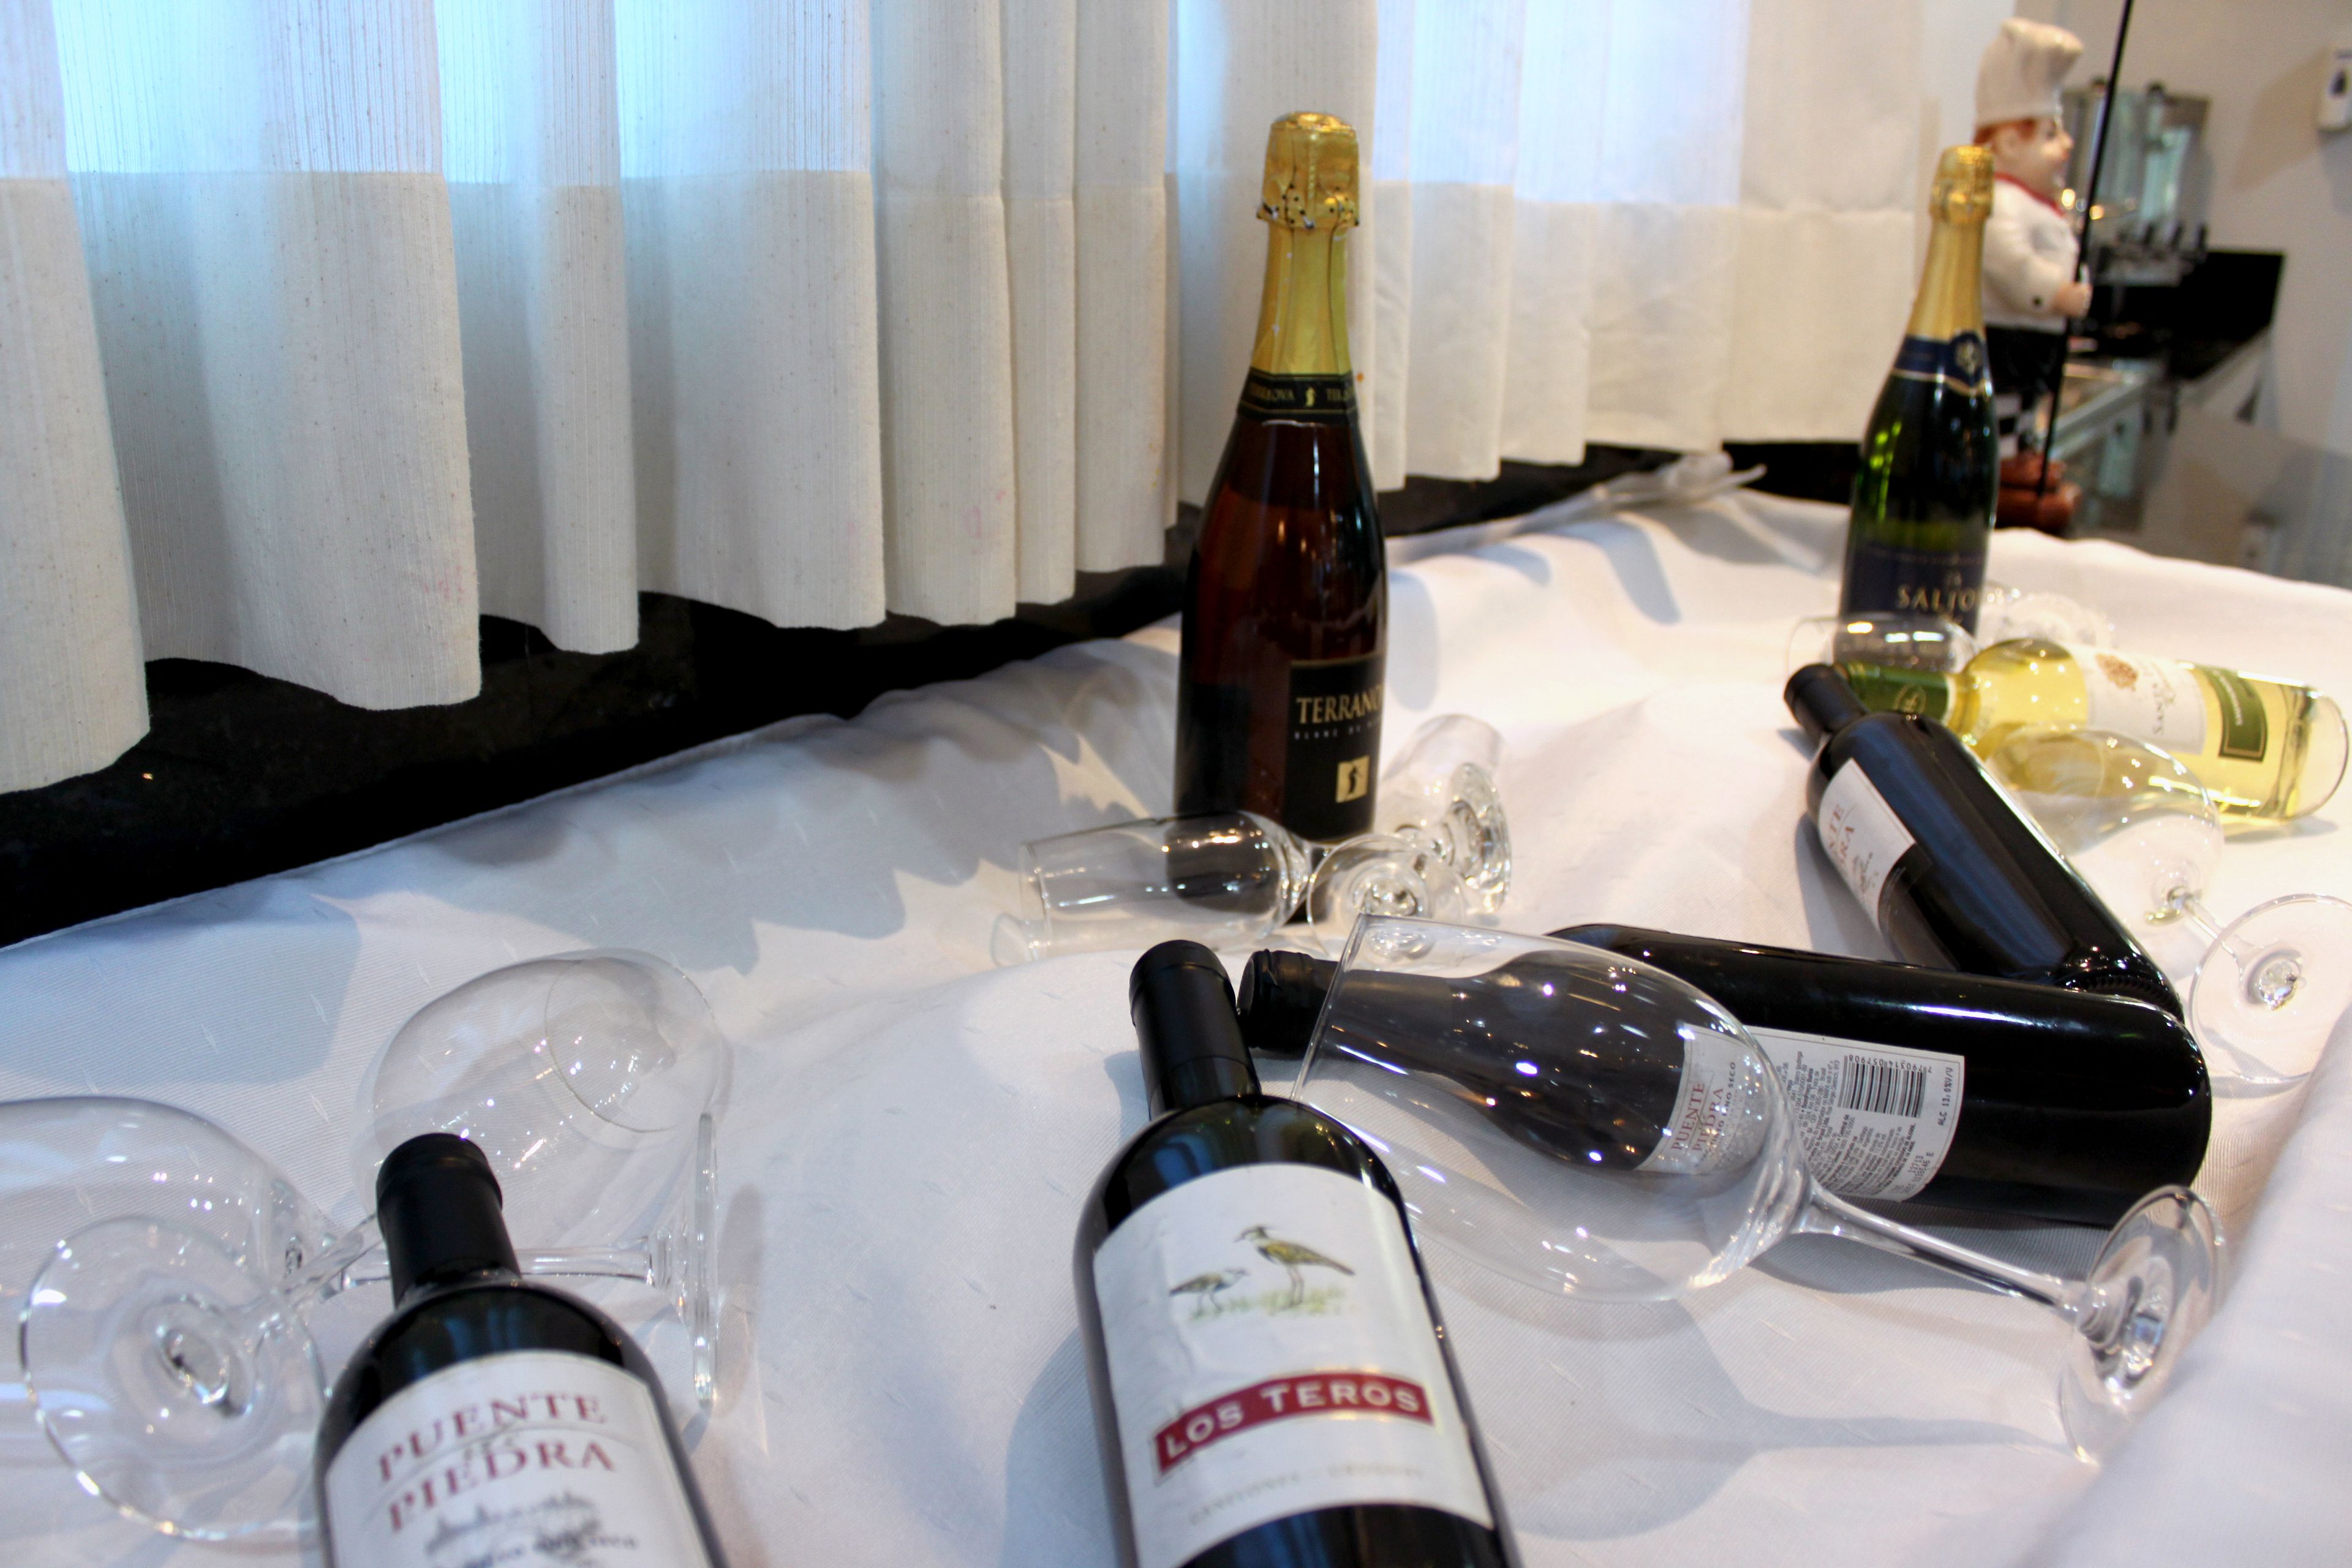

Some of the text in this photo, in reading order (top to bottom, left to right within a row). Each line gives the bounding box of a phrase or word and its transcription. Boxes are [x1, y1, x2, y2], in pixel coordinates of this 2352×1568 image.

[1728, 1061, 1736, 1088] SECO
[1671, 1083, 1705, 1150] PUENTE
[1692, 1088, 1724, 1151] PIEDRA
[378, 1392, 609, 1483] PUENTE
[1165, 1379, 1421, 1458] LOS TEROS
[388, 1441, 615, 1532] PIEDRA
